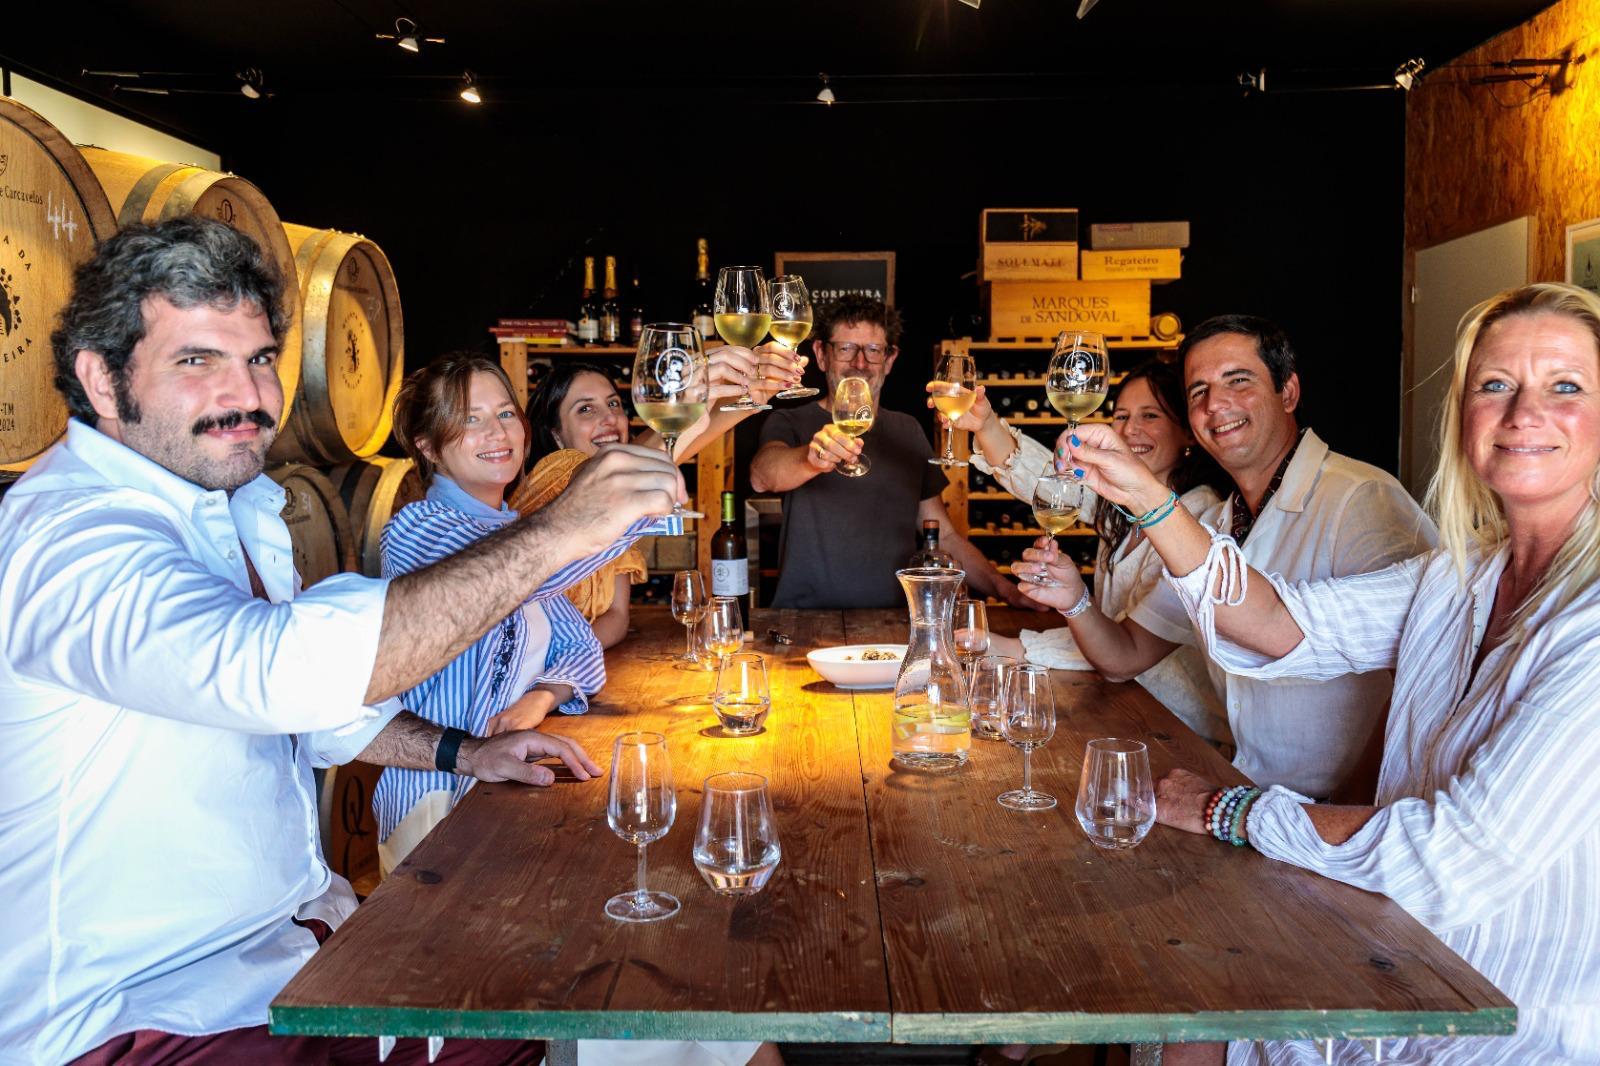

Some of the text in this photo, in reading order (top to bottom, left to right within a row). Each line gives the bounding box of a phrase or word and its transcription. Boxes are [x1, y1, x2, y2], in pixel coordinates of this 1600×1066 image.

[4, 185, 43, 205] Carcavelos
[47, 190, 78, 242] 44
[1104, 256, 1159, 267] Regateiro
[1032, 296, 1109, 311] MARQUES
[1035, 310, 1120, 323] SANDOVAL
